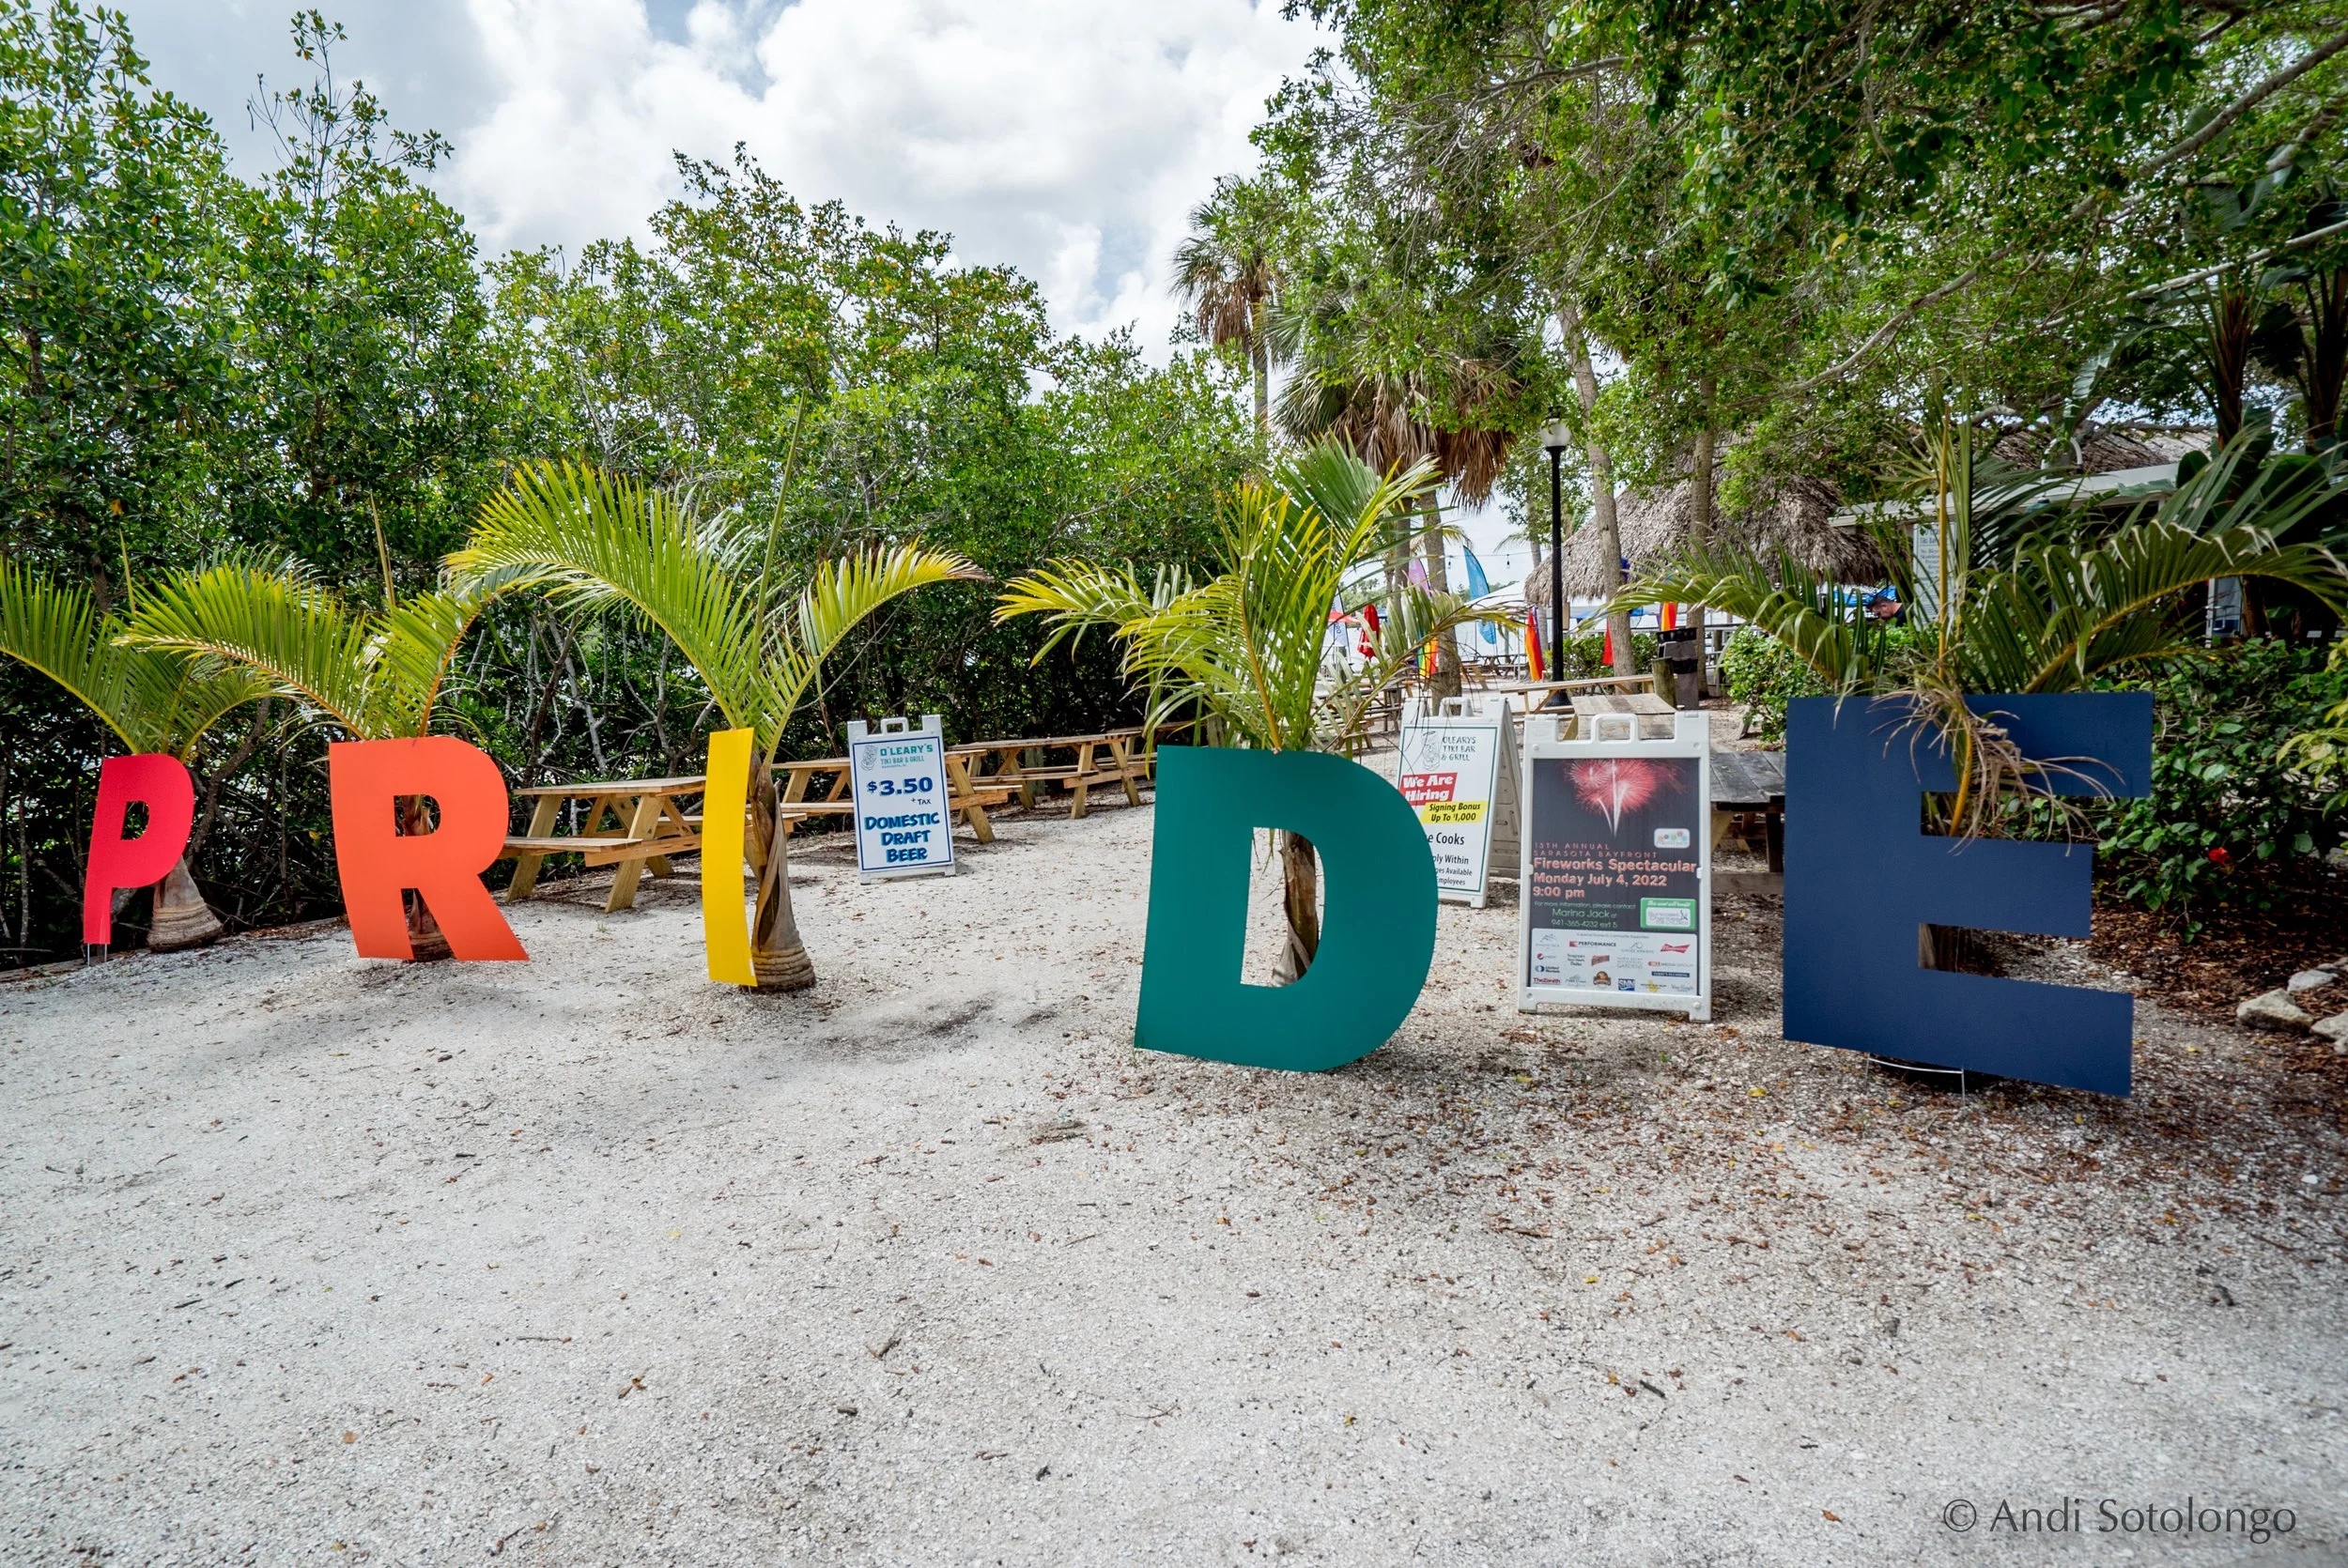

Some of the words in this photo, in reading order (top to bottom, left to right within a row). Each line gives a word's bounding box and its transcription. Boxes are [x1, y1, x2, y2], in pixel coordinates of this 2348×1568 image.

[879, 743, 934, 757] O'LEARY'S
[909, 755, 925, 763] GRILL
[867, 776, 934, 797] $3.50
[1403, 776, 1425, 789] We
[1426, 775, 1454, 787] Are
[1404, 789, 1450, 802] Hiring
[1429, 804, 1456, 813] Signing
[864, 811, 940, 831] DOMESTIC
[1430, 813, 1442, 822] Up
[1443, 813, 1451, 822] To
[881, 830, 931, 846] DRAFT
[1436, 832, 1464, 845] Cooks
[886, 847, 928, 863] BEER
[1444, 854, 1469, 864] Within
[1534, 856, 1604, 870] Fireworks
[1608, 858, 1697, 873] Spectacular
[1446, 868, 1473, 876] Available
[1437, 877, 1466, 886] mployees
[1534, 872, 1584, 886] Monday
[1587, 873, 1613, 887] July
[1615, 874, 1629, 887] 4,
[1632, 874, 1667, 886] 2022
[1533, 886, 1561, 897] 9:00
[1565, 889, 1585, 900] pm
[1552, 908, 1585, 917] Marina
[1586, 909, 1610, 918] Jack
